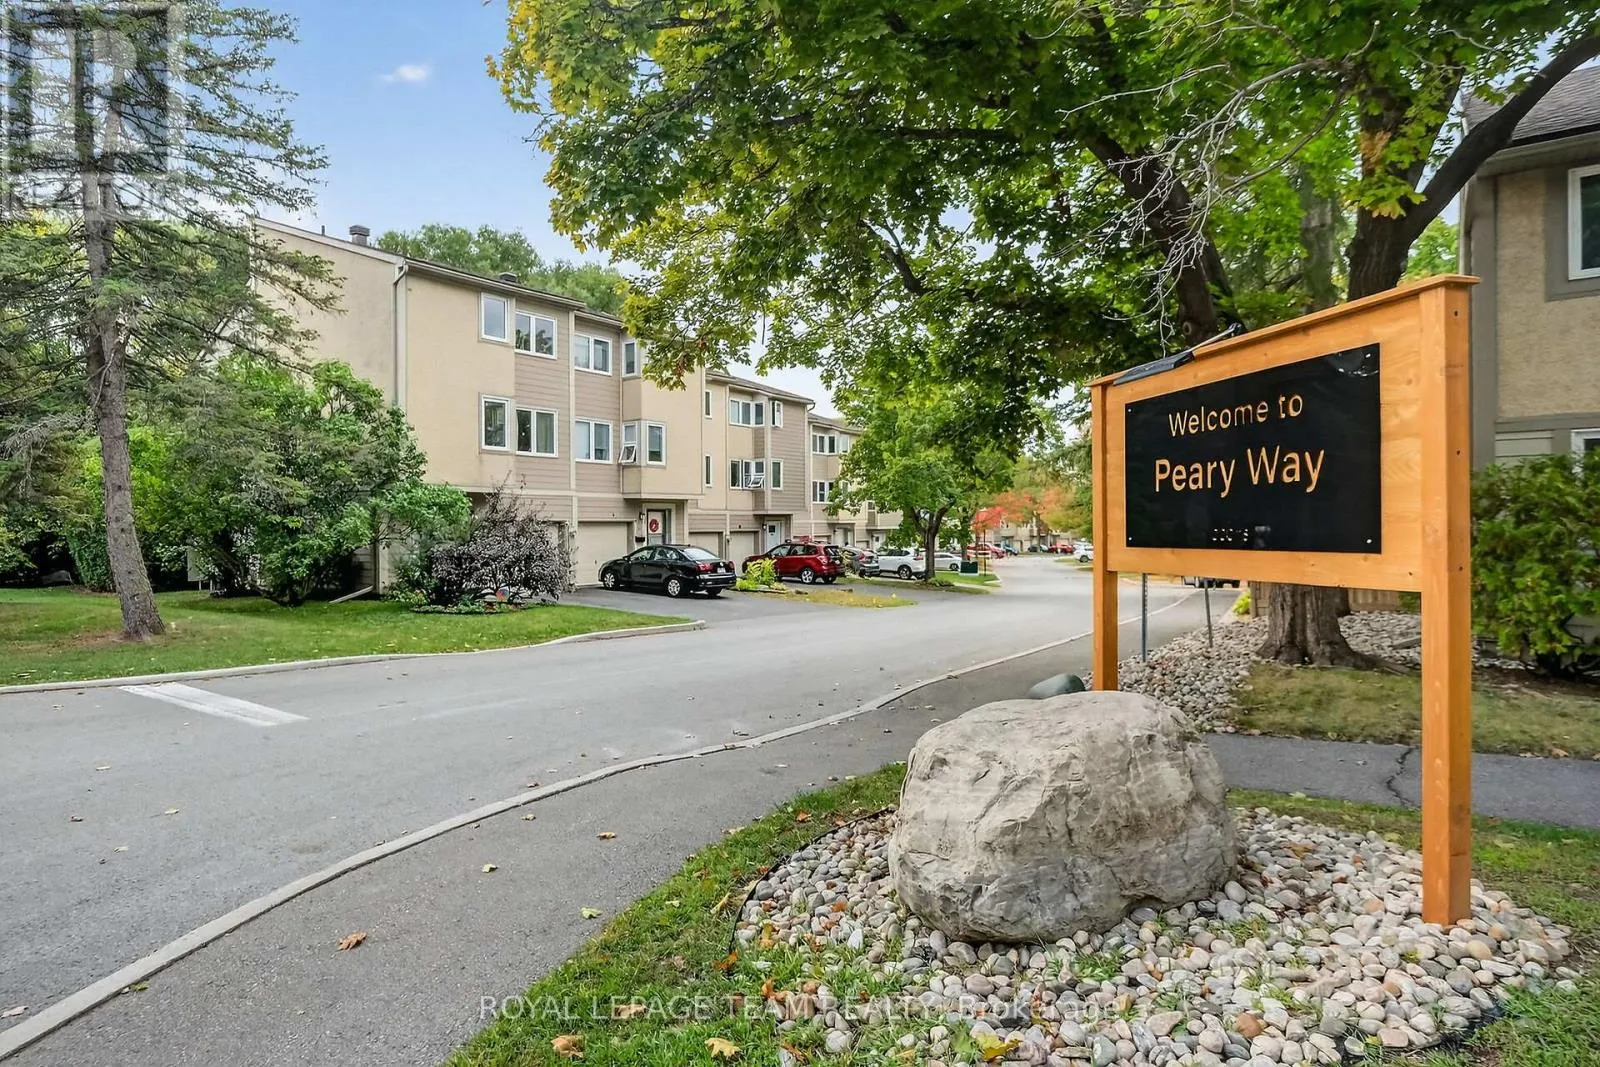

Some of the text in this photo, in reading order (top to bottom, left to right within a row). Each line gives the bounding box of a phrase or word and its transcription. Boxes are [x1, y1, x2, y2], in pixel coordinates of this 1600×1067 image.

[1168, 393, 1303, 437] Welcome to
[1155, 445, 1325, 498] Peary Way
